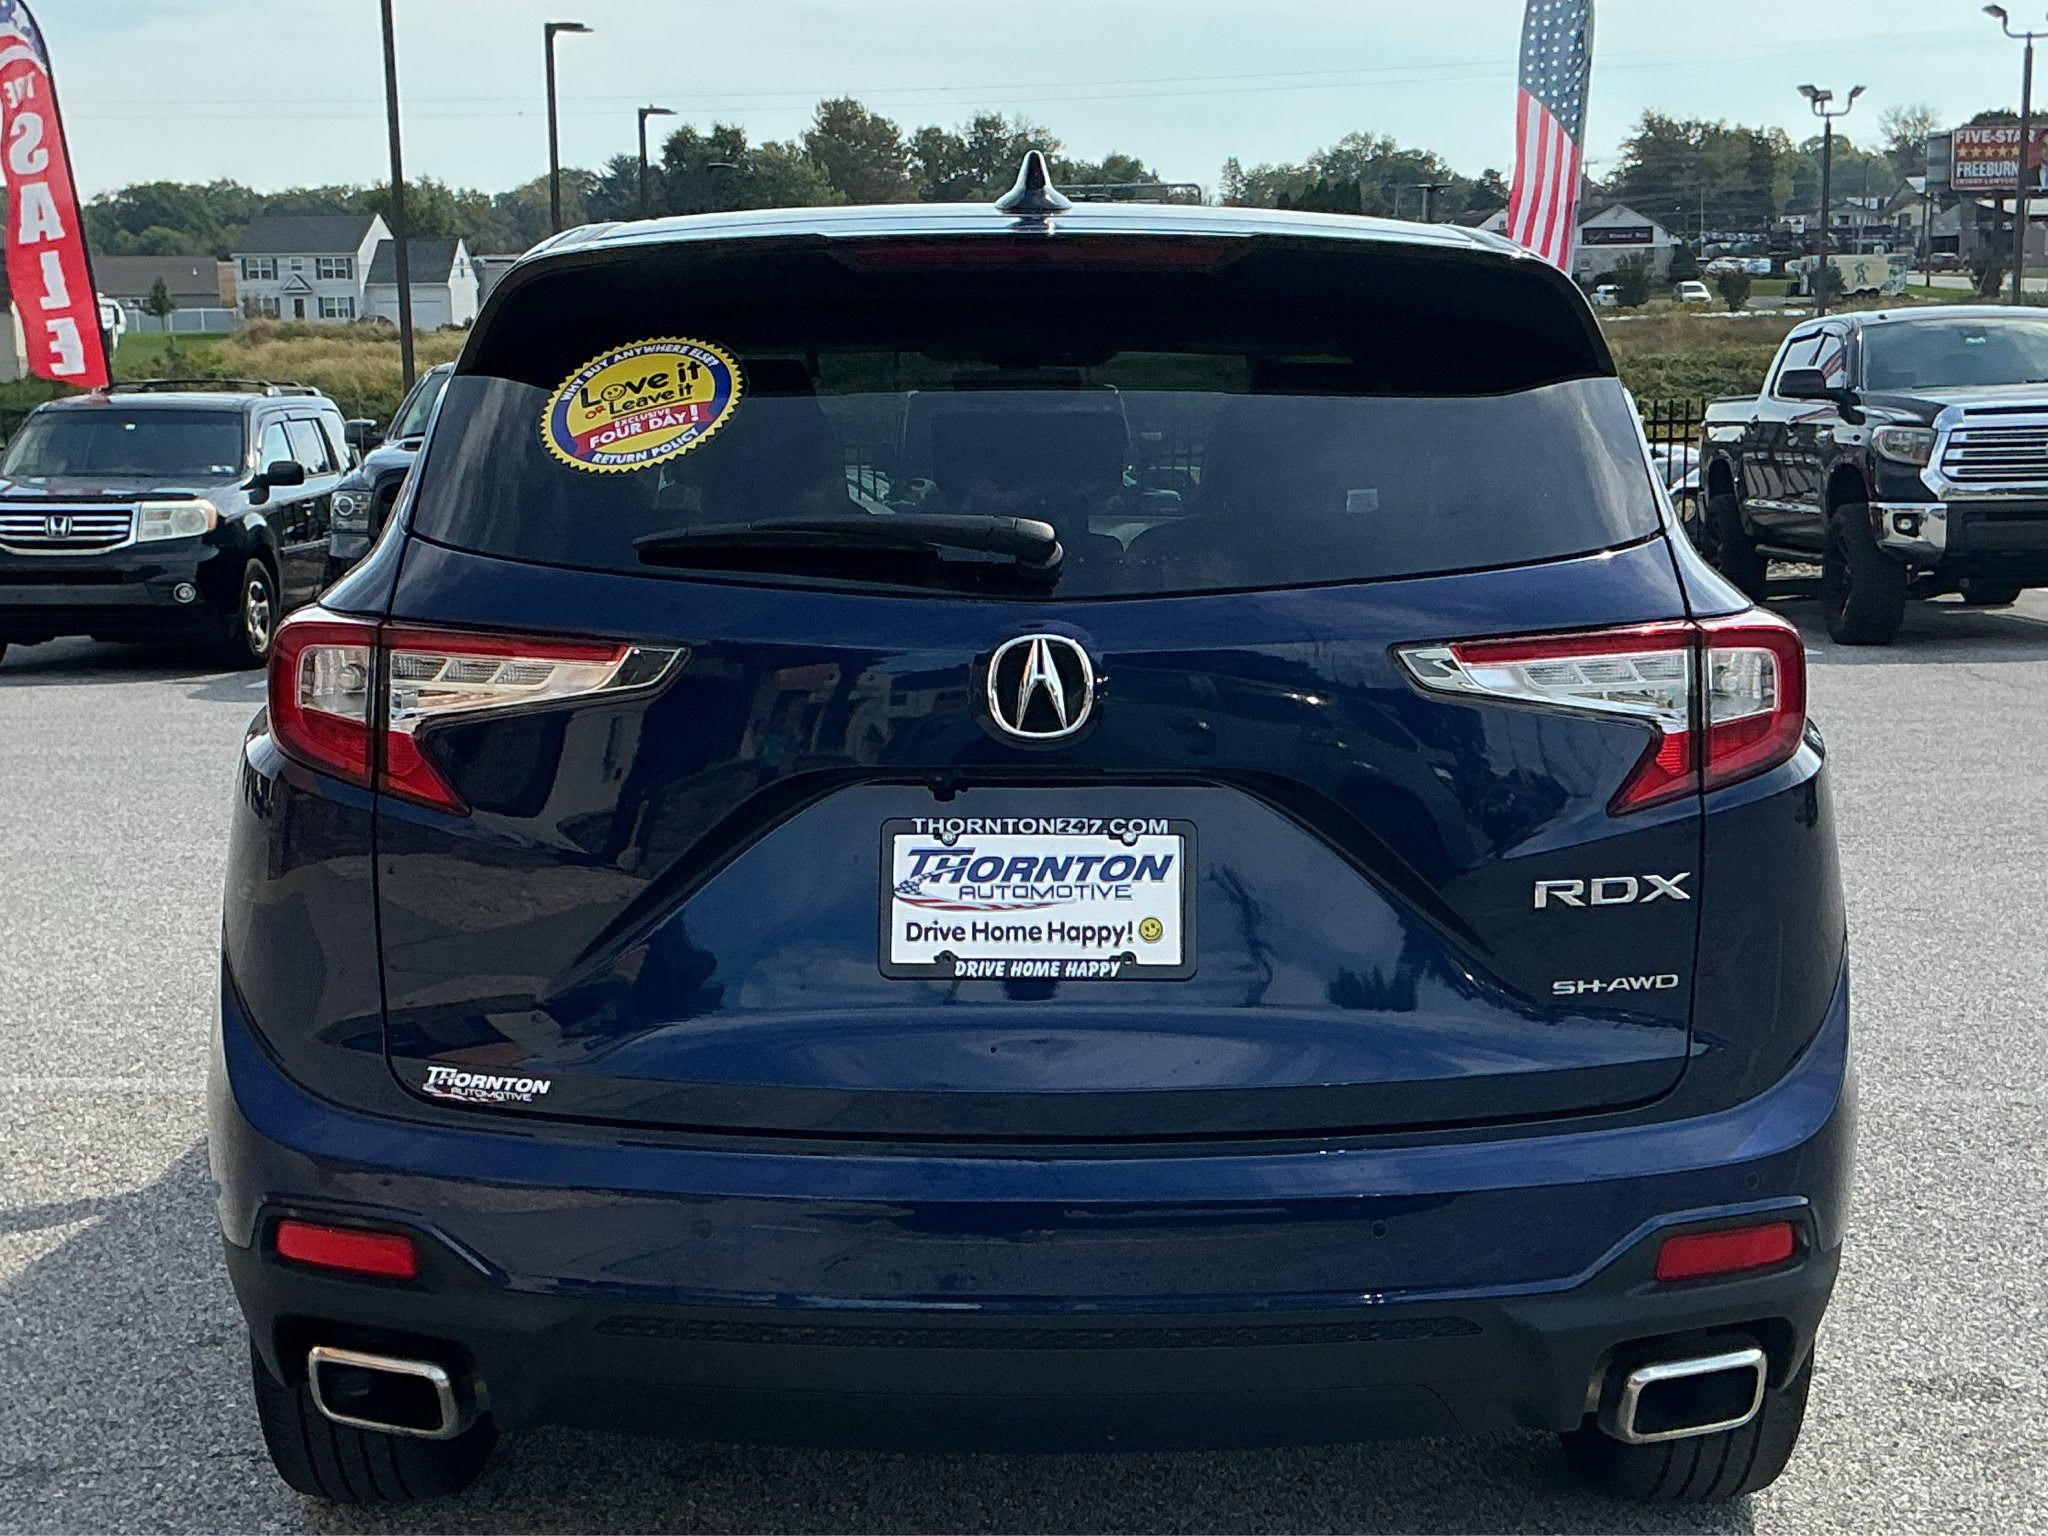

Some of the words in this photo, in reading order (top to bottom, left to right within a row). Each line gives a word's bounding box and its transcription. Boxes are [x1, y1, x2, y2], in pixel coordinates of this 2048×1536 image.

[1956, 161, 2019, 178] FREEBURN
[560, 377, 584, 401] WHY
[583, 358, 608, 378] BUY
[613, 343, 688, 362] ANYWHERE
[580, 372, 670, 408] Love
[676, 361, 701, 383] it
[609, 388, 675, 415] Leave
[678, 383, 694, 397] it
[584, 405, 607, 420] OR
[614, 408, 671, 428] EXCLUSIVE
[589, 423, 643, 449] FOUR
[592, 450, 648, 464] RETURN
[651, 428, 699, 458] POLICY
[958, 884, 1134, 901] AUTOMOTIVE
[1534, 871, 1691, 909] RDX
[906, 920, 966, 943] Drive
[972, 921, 1043, 942] Home
[1048, 921, 1133, 948] Happy!
[954, 960, 1006, 977] DRIVE
[1010, 960, 1061, 977] HOME
[1064, 960, 1121, 977] HAPPY
[1552, 973, 1679, 996] SH-AWD
[450, 1087, 533, 1102] AUTOMOTIVE
